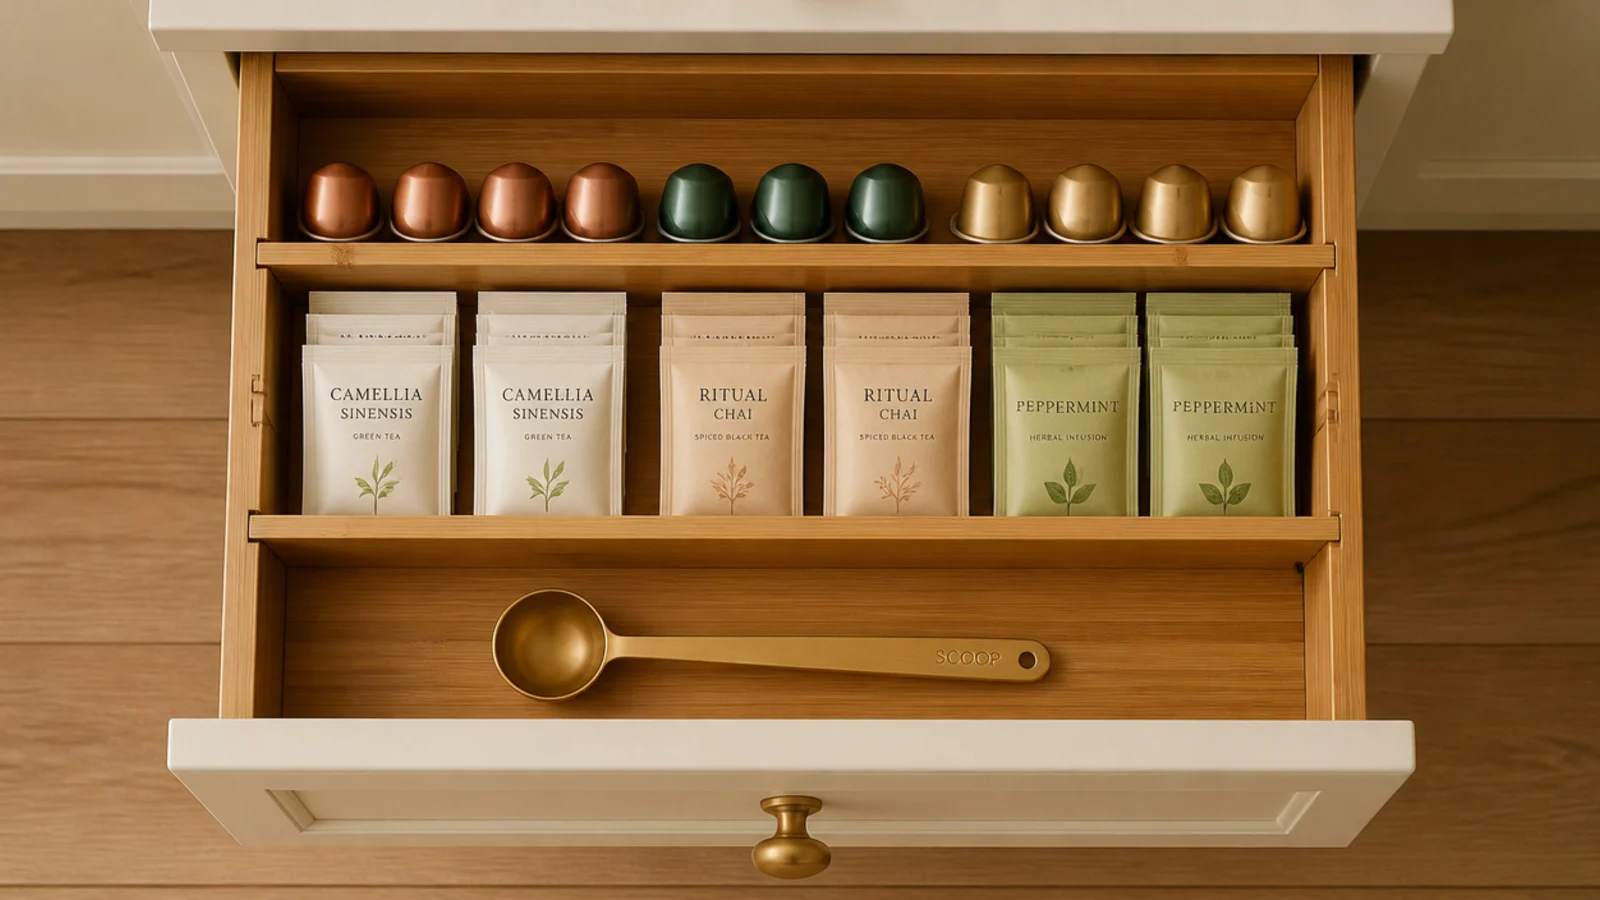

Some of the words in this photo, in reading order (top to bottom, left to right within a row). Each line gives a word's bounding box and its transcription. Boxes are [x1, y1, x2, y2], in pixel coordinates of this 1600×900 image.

[330, 387, 423, 401] CAMELLIA
[502, 387, 594, 401] CAMELLIA
[699, 388, 768, 402] RITUAL
[864, 388, 933, 402] RITUAL
[340, 407, 413, 419] SINENSIS
[512, 407, 584, 419] SINENSIS
[1015, 400, 1120, 414] PEPPERMINT
[713, 408, 753, 420] CHAI
[879, 408, 917, 420] CHAI
[352, 432, 382, 441] GREEN
[384, 432, 401, 441] TEA
[524, 433, 553, 441] GREEN
[556, 433, 572, 441] TEA
[694, 433, 724, 441] SPICED
[726, 433, 753, 441] BLACK
[755, 433, 770, 441] TEA
[859, 433, 889, 441] SPICED
[891, 433, 918, 441] BLACK
[920, 433, 935, 441] TEA
[1029, 433, 1063, 441] HERBAL
[1065, 433, 1108, 441] INFUSION
[1187, 433, 1220, 442] HERBAL
[1223, 433, 1265, 442] INFUSION
[935, 649, 1002, 666] SCOOP
